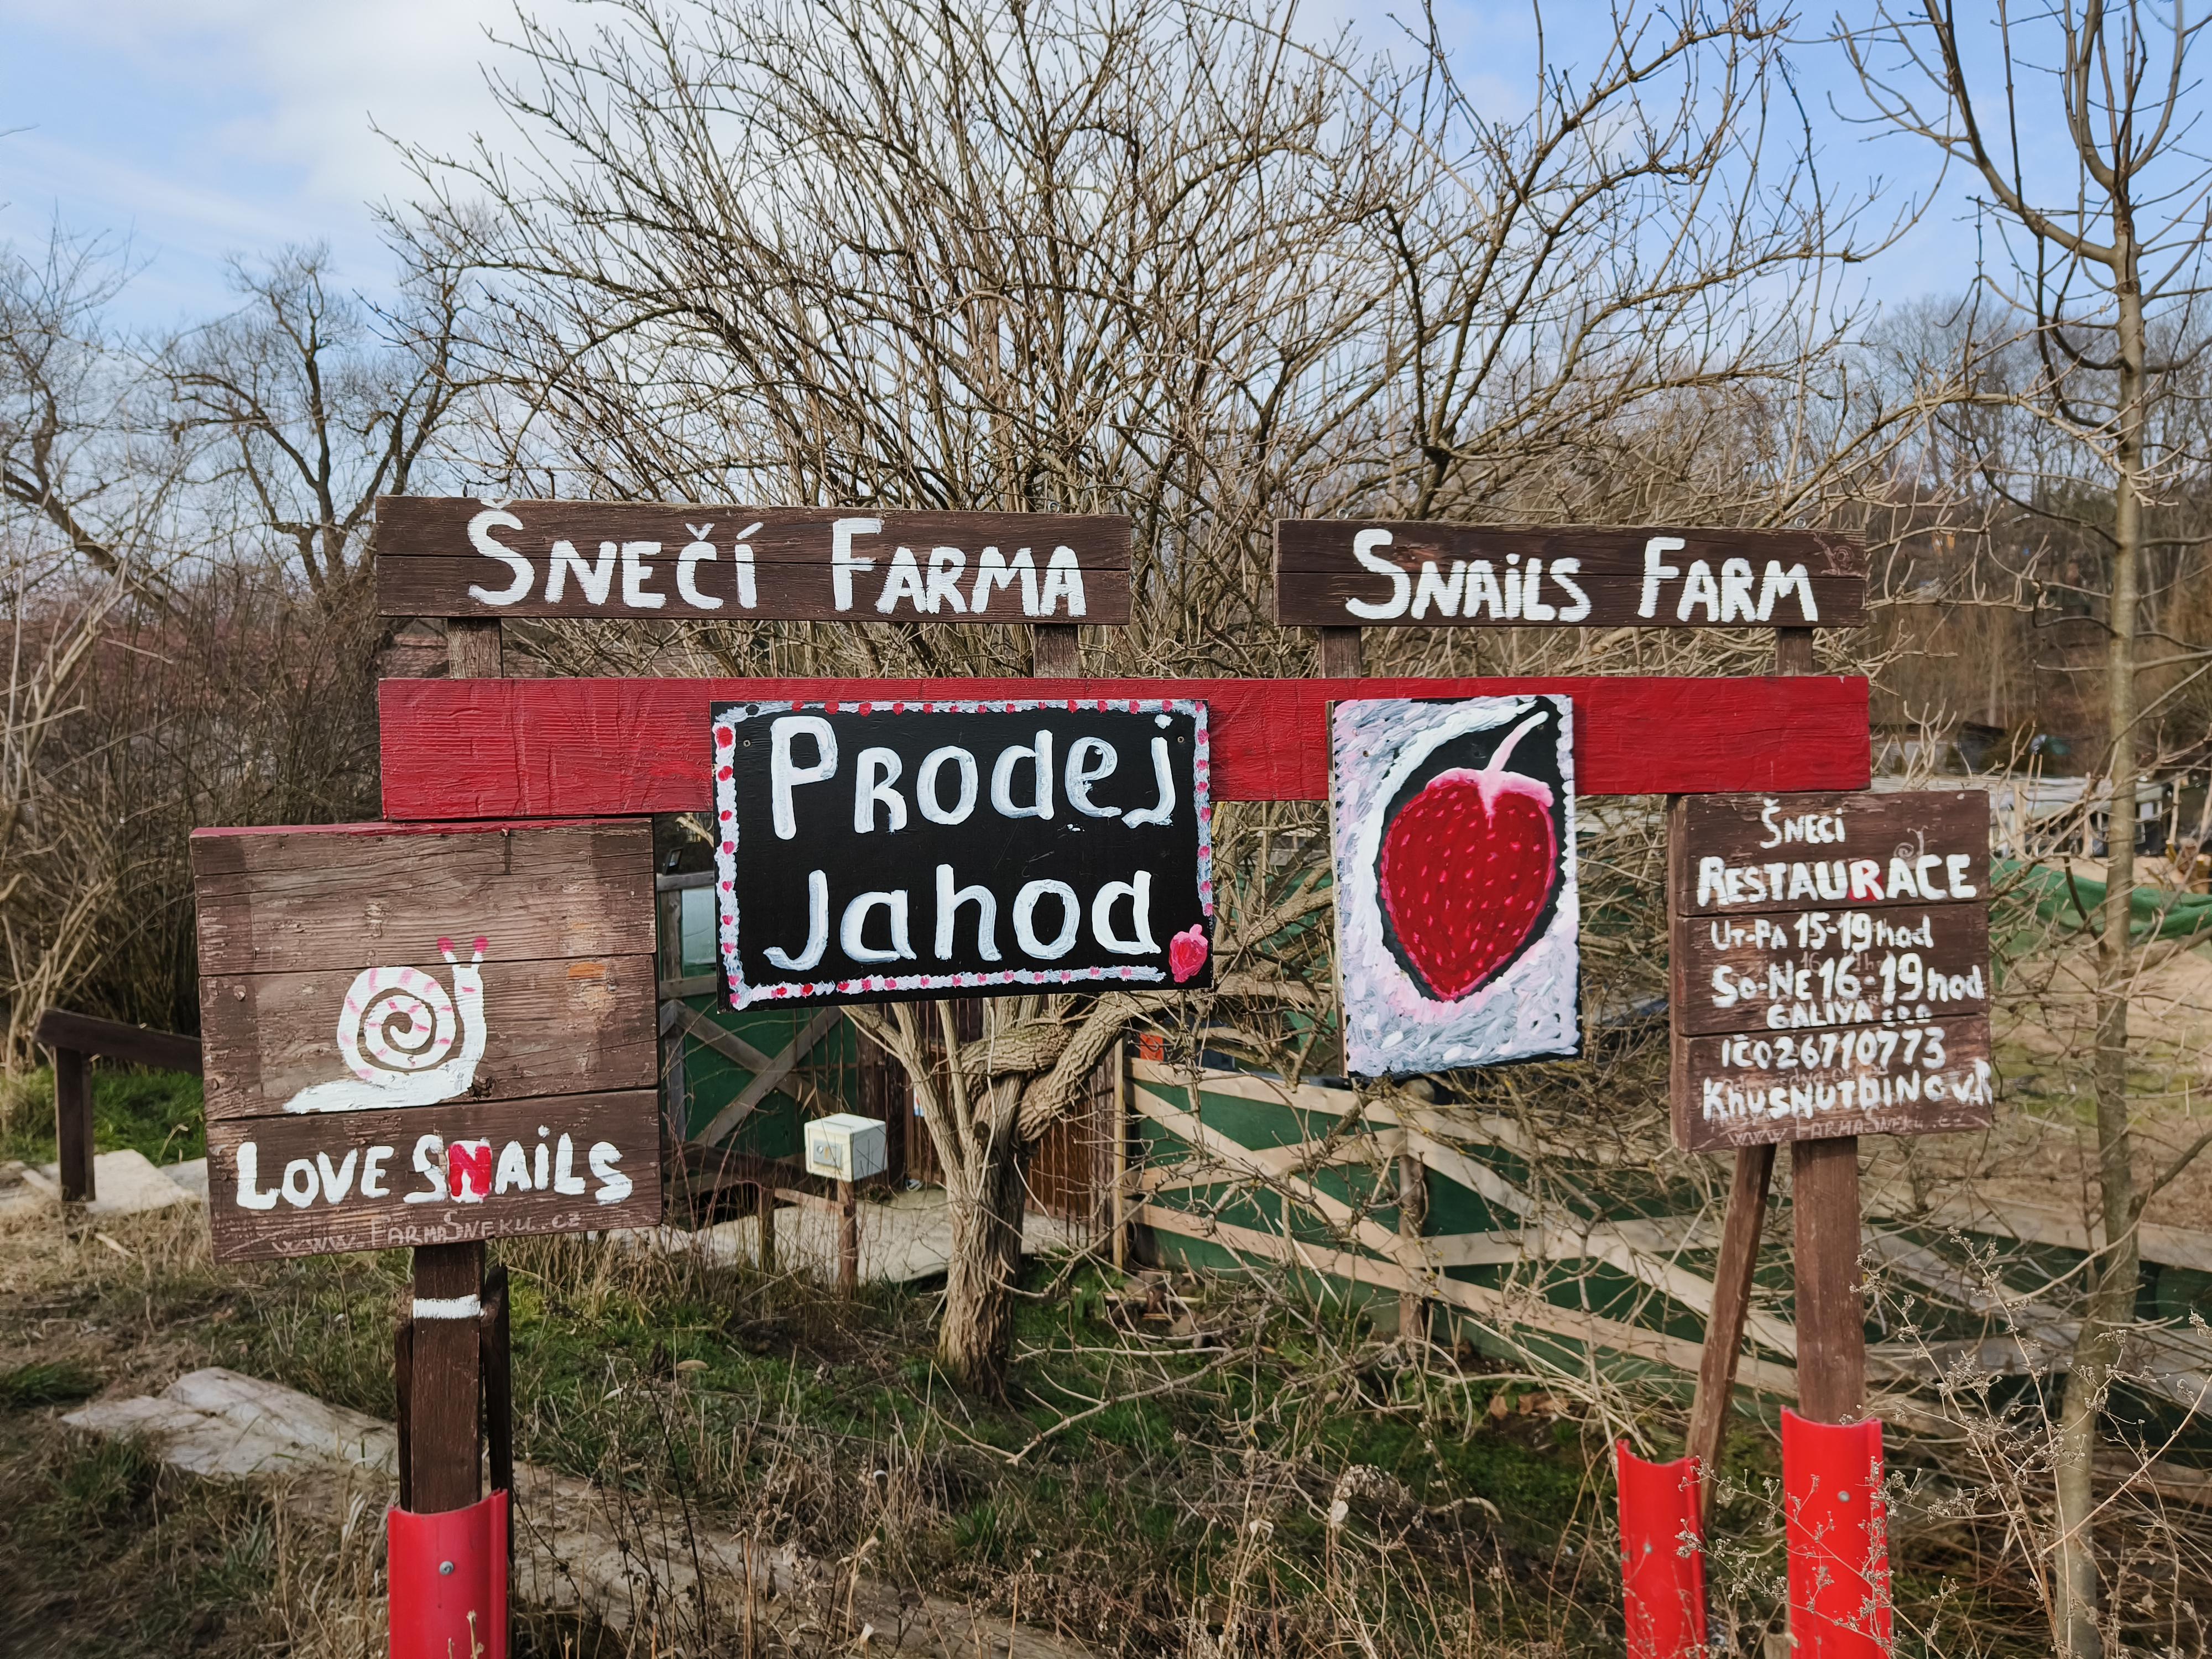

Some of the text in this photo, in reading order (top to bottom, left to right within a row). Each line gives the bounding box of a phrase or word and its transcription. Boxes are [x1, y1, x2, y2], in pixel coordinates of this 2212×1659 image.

[467, 499, 1087, 617] ŠNEČÍ FARMA
[1637, 537, 1818, 623] FARM
[763, 864, 1162, 977] Jahod
[1697, 854, 1977, 907] RESTAURACE
[236, 1141, 394, 1210] LOVE
